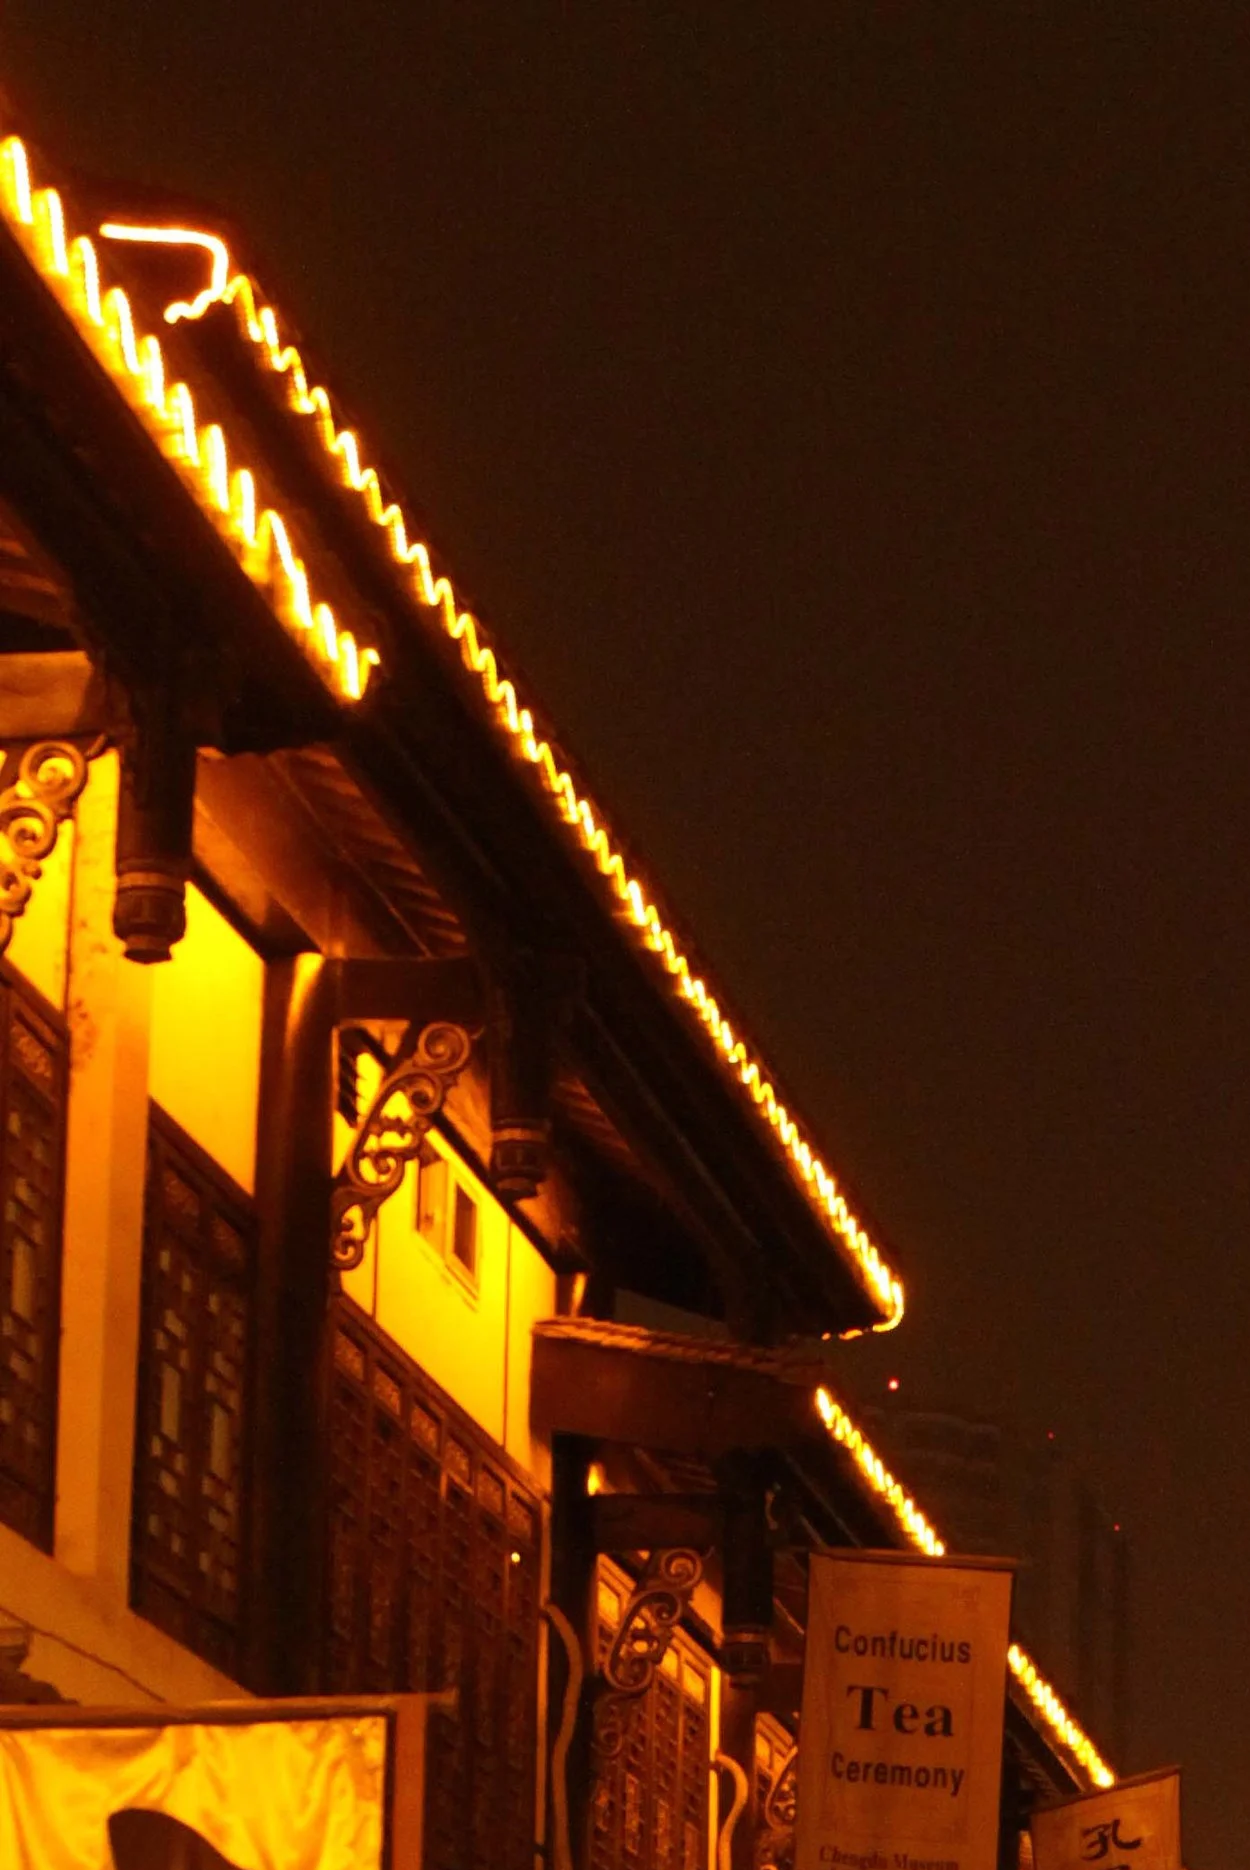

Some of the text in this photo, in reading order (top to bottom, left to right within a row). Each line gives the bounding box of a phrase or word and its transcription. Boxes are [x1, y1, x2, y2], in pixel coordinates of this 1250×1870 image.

[834, 1624, 972, 1665] Confucius
[846, 1685, 954, 1738] Tea
[831, 1751, 965, 1797] Ceremony
[818, 1844, 888, 1870] Chengdu
